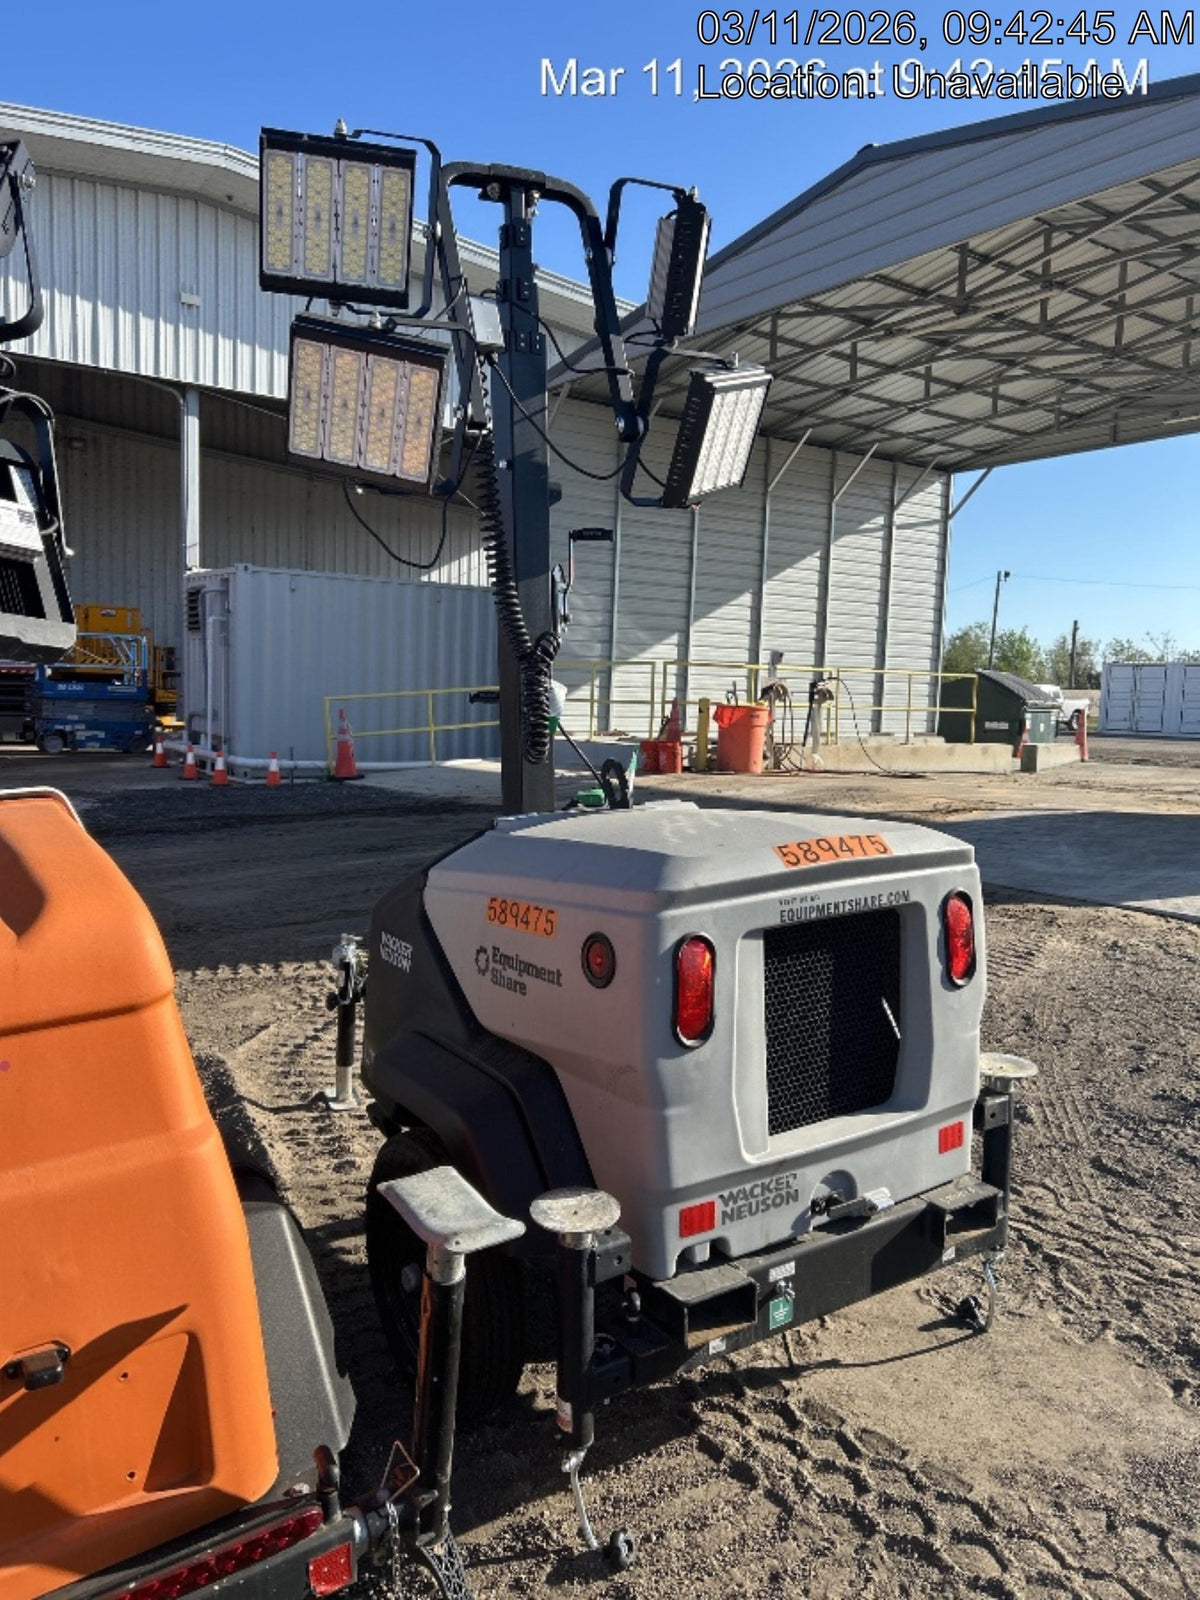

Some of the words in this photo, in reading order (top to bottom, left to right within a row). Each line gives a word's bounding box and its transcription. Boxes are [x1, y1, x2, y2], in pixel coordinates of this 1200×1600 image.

[776, 834, 889, 867] 589475
[487, 897, 556, 937] 589475
[779, 889, 911, 924] EQUIPMENTSHARE.COM
[489, 966, 528, 997] Share
[490, 945, 564, 988] Equipment
[718, 1172, 798, 1208] WACKER
[721, 1188, 799, 1226] NEUSON
